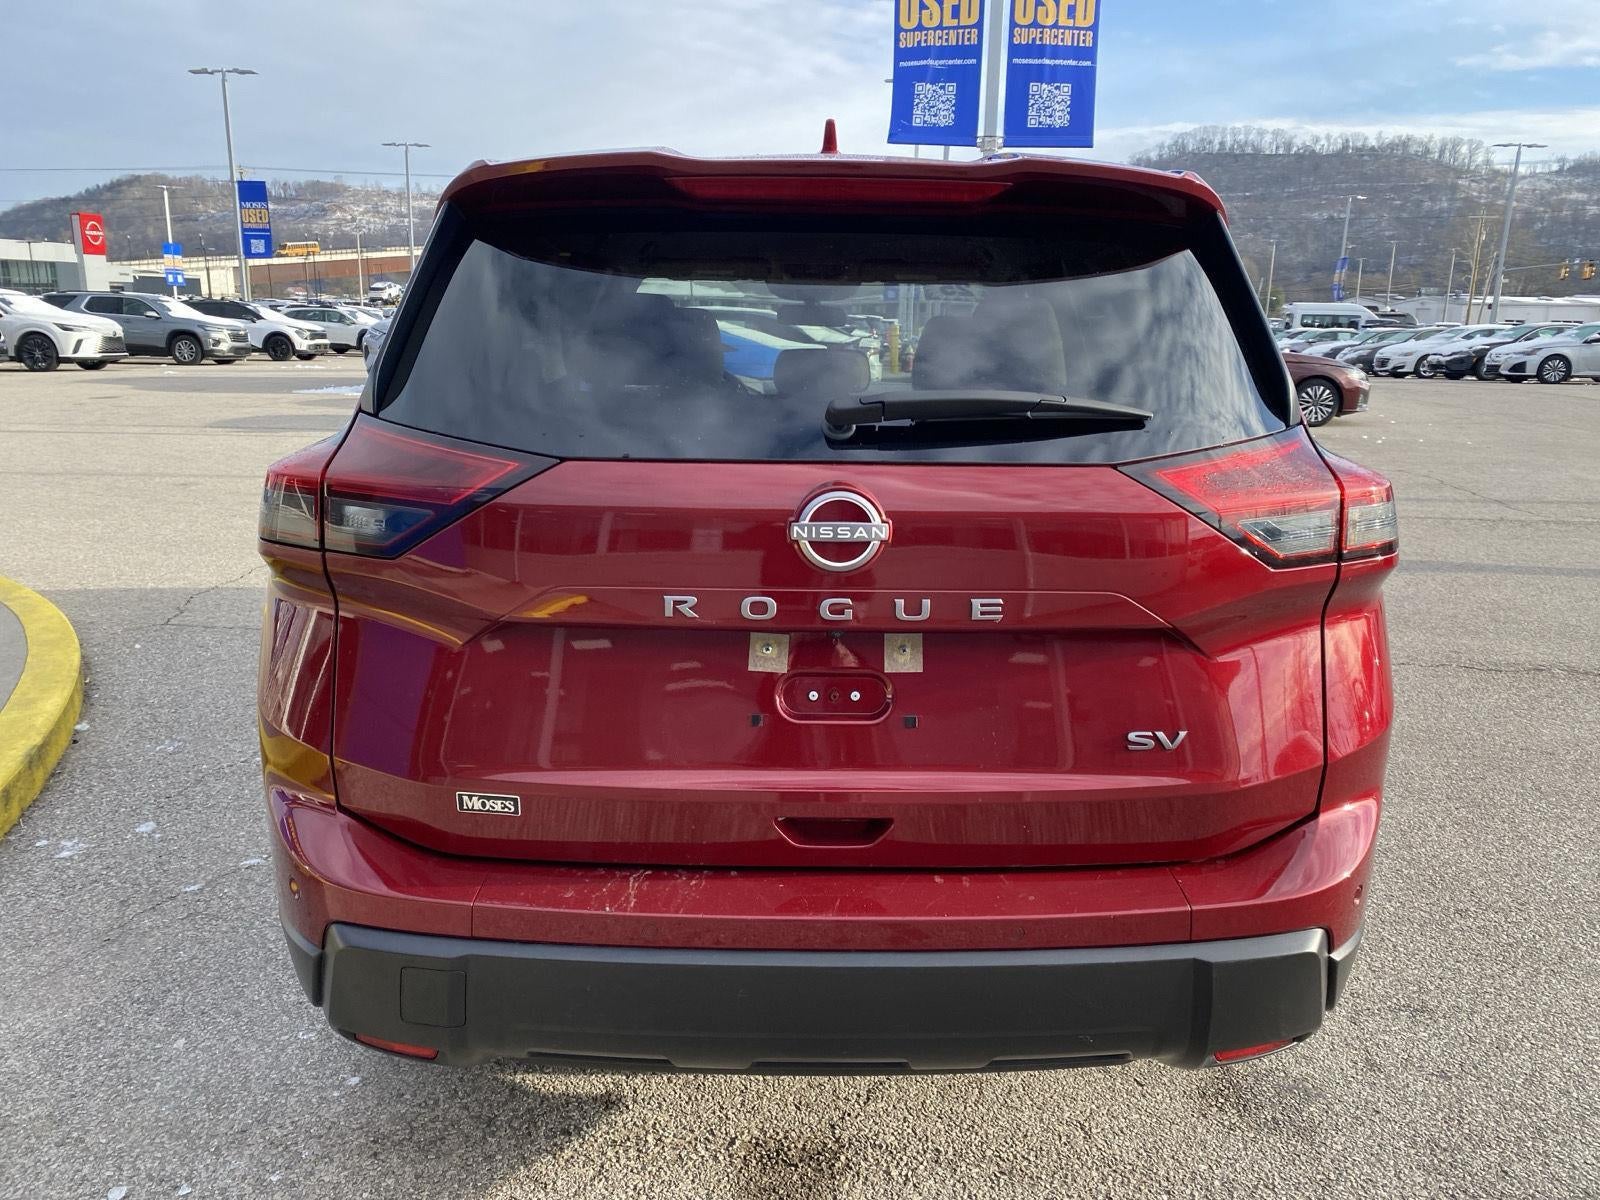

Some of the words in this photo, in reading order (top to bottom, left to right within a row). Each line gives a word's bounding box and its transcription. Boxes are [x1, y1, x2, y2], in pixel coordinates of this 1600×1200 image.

[899, 0, 979, 29] USED
[1014, 0, 1095, 27] USED
[899, 28, 978, 48] SUPERCENTER
[1013, 27, 1093, 47] SUPERCENTER
[899, 58, 977, 67] mosesusedsupercenter.com
[1012, 58, 1092, 66] mosesusedsupercenter.com
[240, 201, 268, 209] MOSES
[241, 208, 269, 223] USED
[793, 526, 886, 539] NISSAN
[663, 595, 1004, 622] ROGUE
[1127, 731, 1188, 750] SV
[462, 795, 515, 813] MOSES
